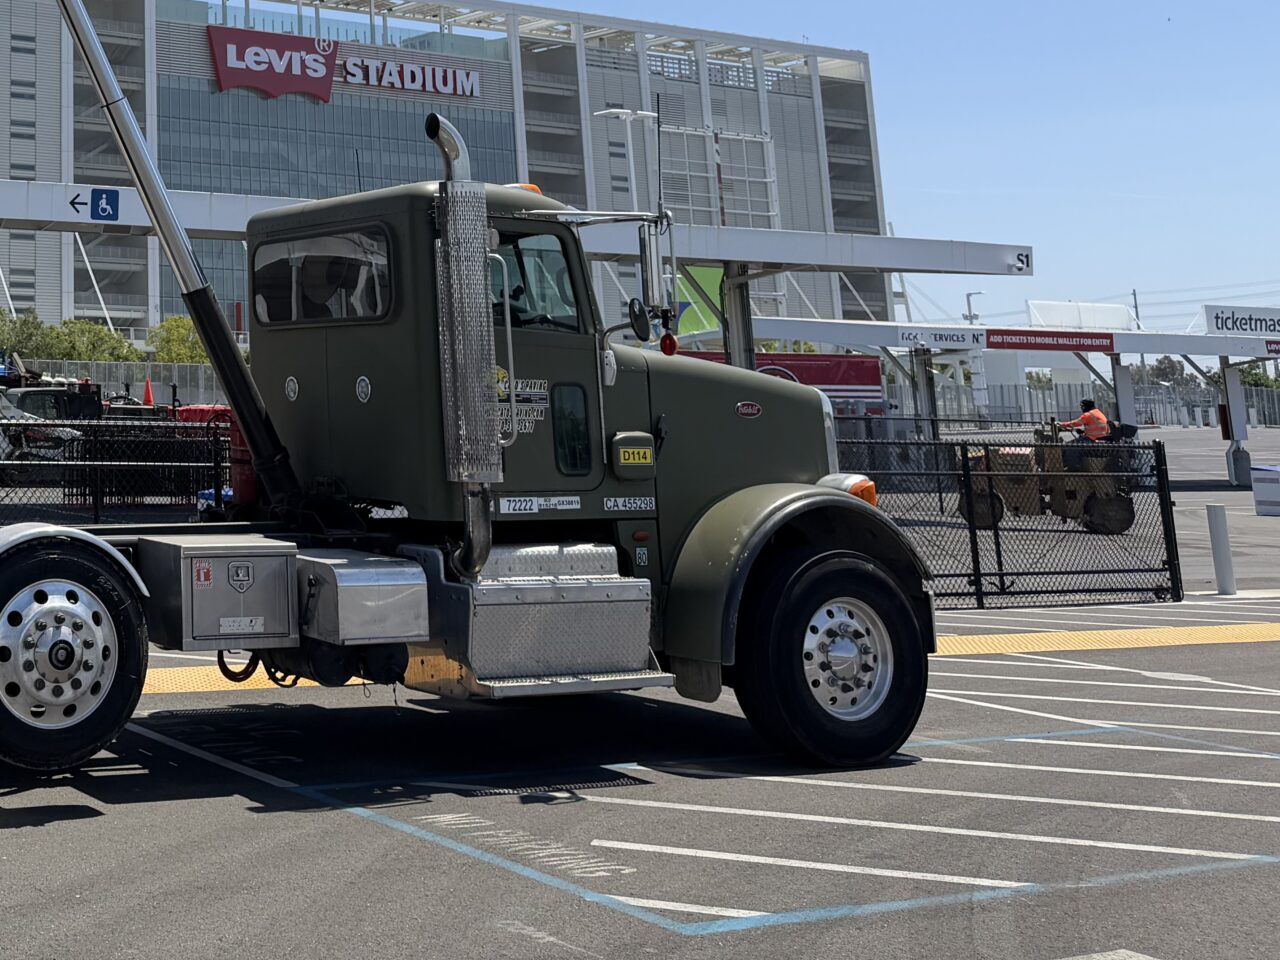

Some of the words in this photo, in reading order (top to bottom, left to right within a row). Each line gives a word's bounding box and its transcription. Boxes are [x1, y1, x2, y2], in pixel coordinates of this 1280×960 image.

[345, 57, 481, 97] STADIUM
[1017, 253, 1030, 268] S1
[989, 335, 1002, 343] ADD
[1003, 335, 1027, 344] TICKETS
[1027, 336, 1035, 344] TO
[1036, 336, 1058, 344] MOBILE
[1058, 337, 1080, 345] WALLET
[1081, 338, 1091, 346] FOR
[1092, 338, 1111, 346] ENTRY
[622, 450, 648, 461] D114
[506, 499, 534, 511] 72222
[605, 499, 619, 510] CA
[622, 498, 654, 510] 455298
